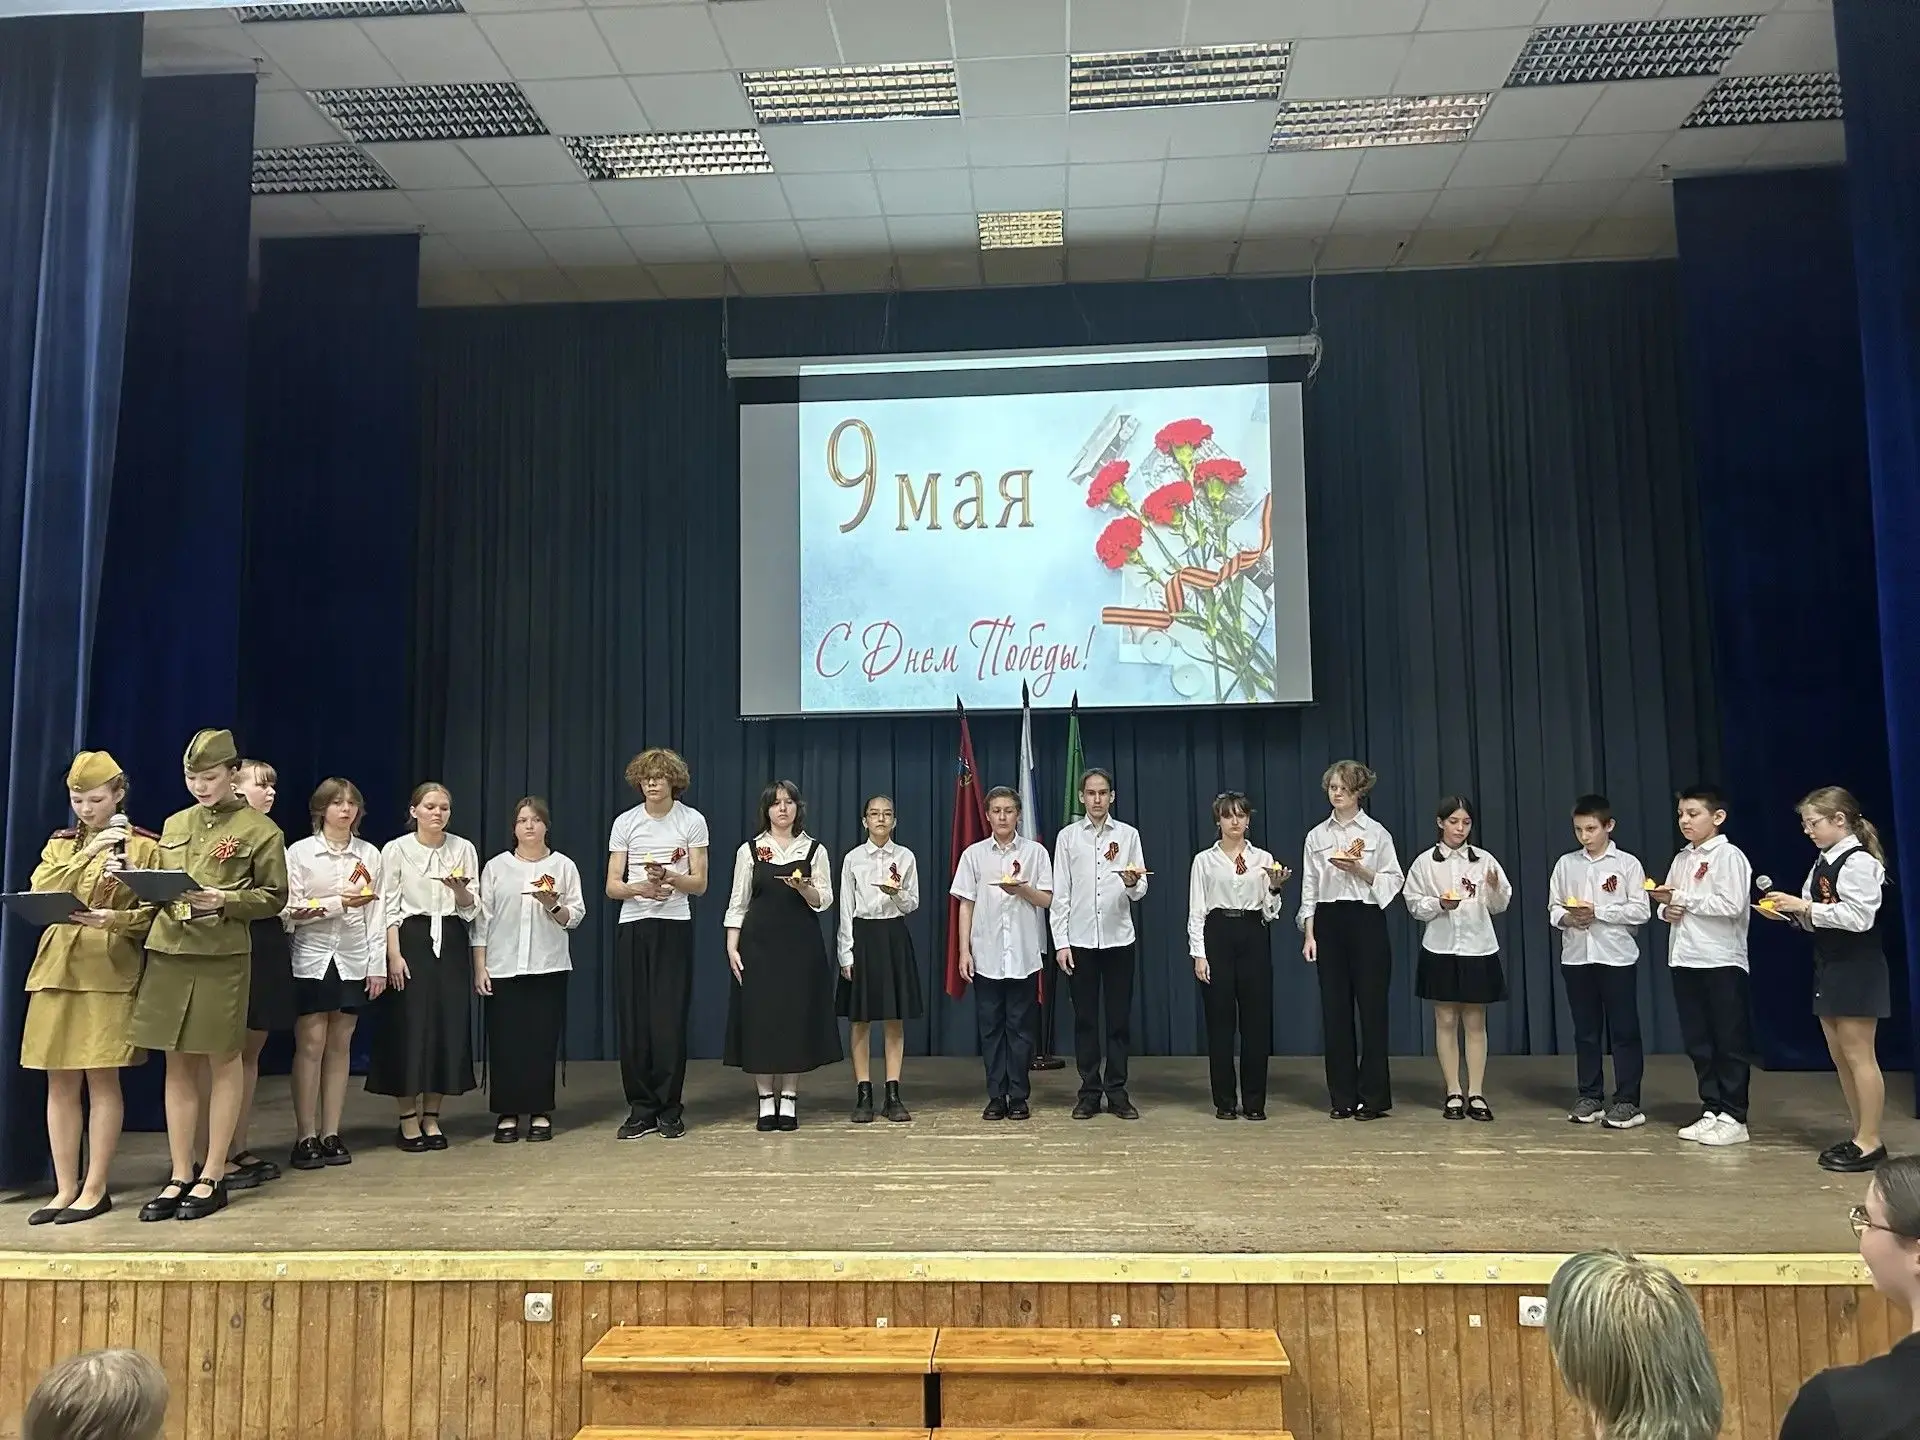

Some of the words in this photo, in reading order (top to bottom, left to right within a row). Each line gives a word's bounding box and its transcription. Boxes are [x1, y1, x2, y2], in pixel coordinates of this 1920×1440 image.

[827, 418, 877, 534] 9
[894, 469, 1034, 531] мая
[815, 621, 853, 678] С
[861, 620, 960, 683] Днем
[968, 615, 1097, 698] Победы!
